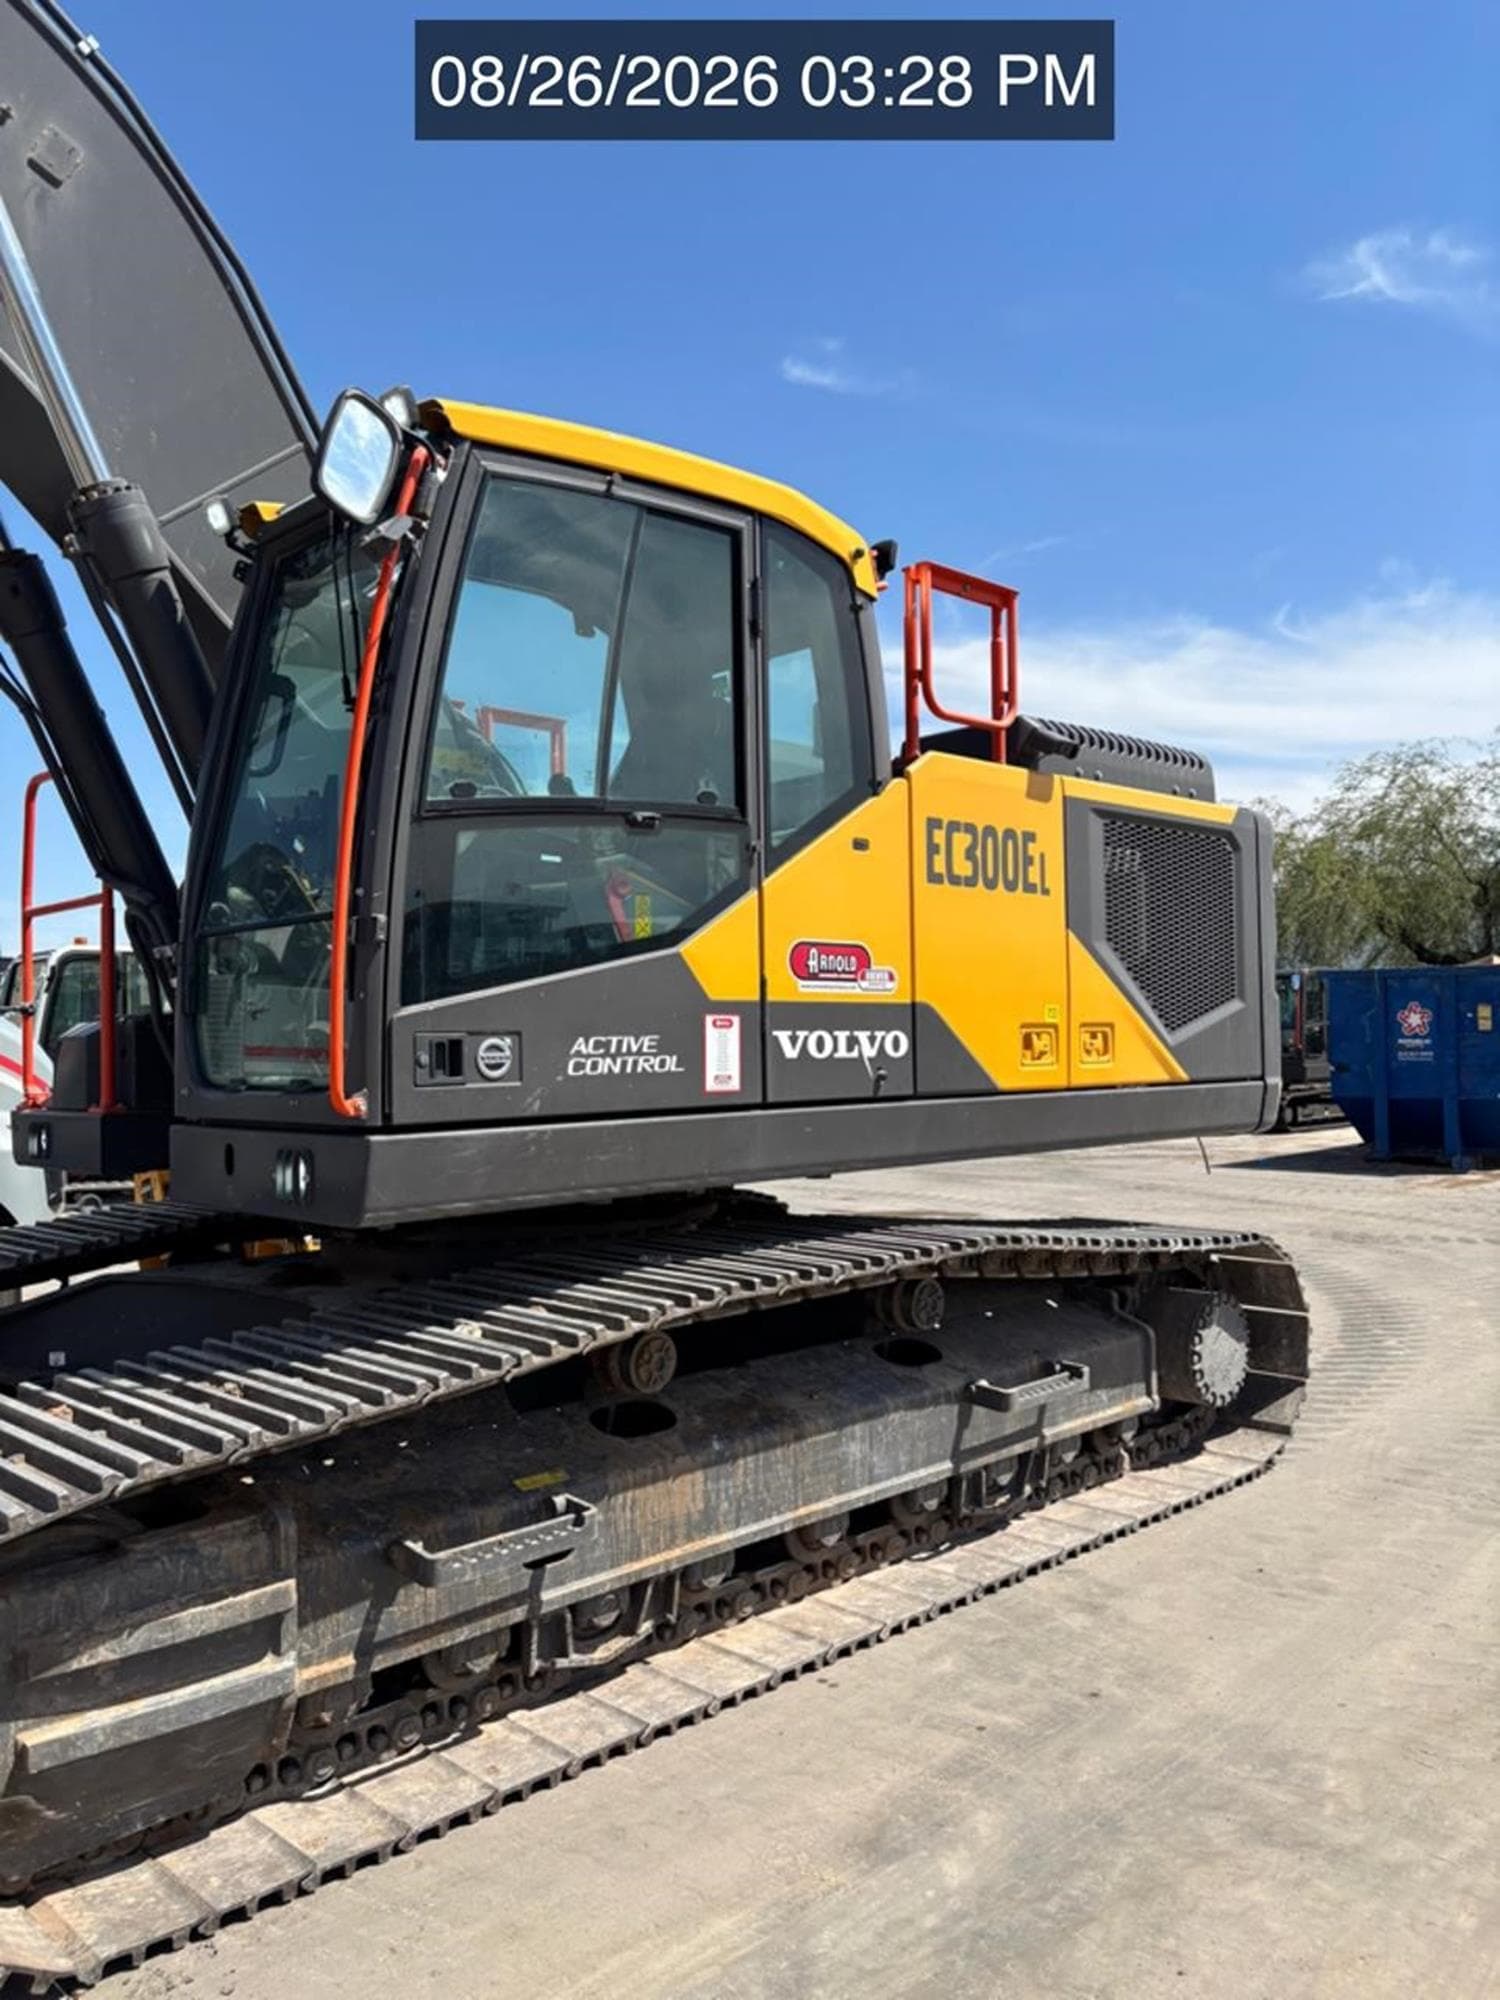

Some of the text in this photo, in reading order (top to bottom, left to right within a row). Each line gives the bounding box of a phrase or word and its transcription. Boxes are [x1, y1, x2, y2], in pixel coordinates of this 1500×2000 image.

[569, 1035, 660, 1055] ACTIVE
[772, 1030, 909, 1059] VOLVO
[566, 1055, 685, 1076] CONTROL
